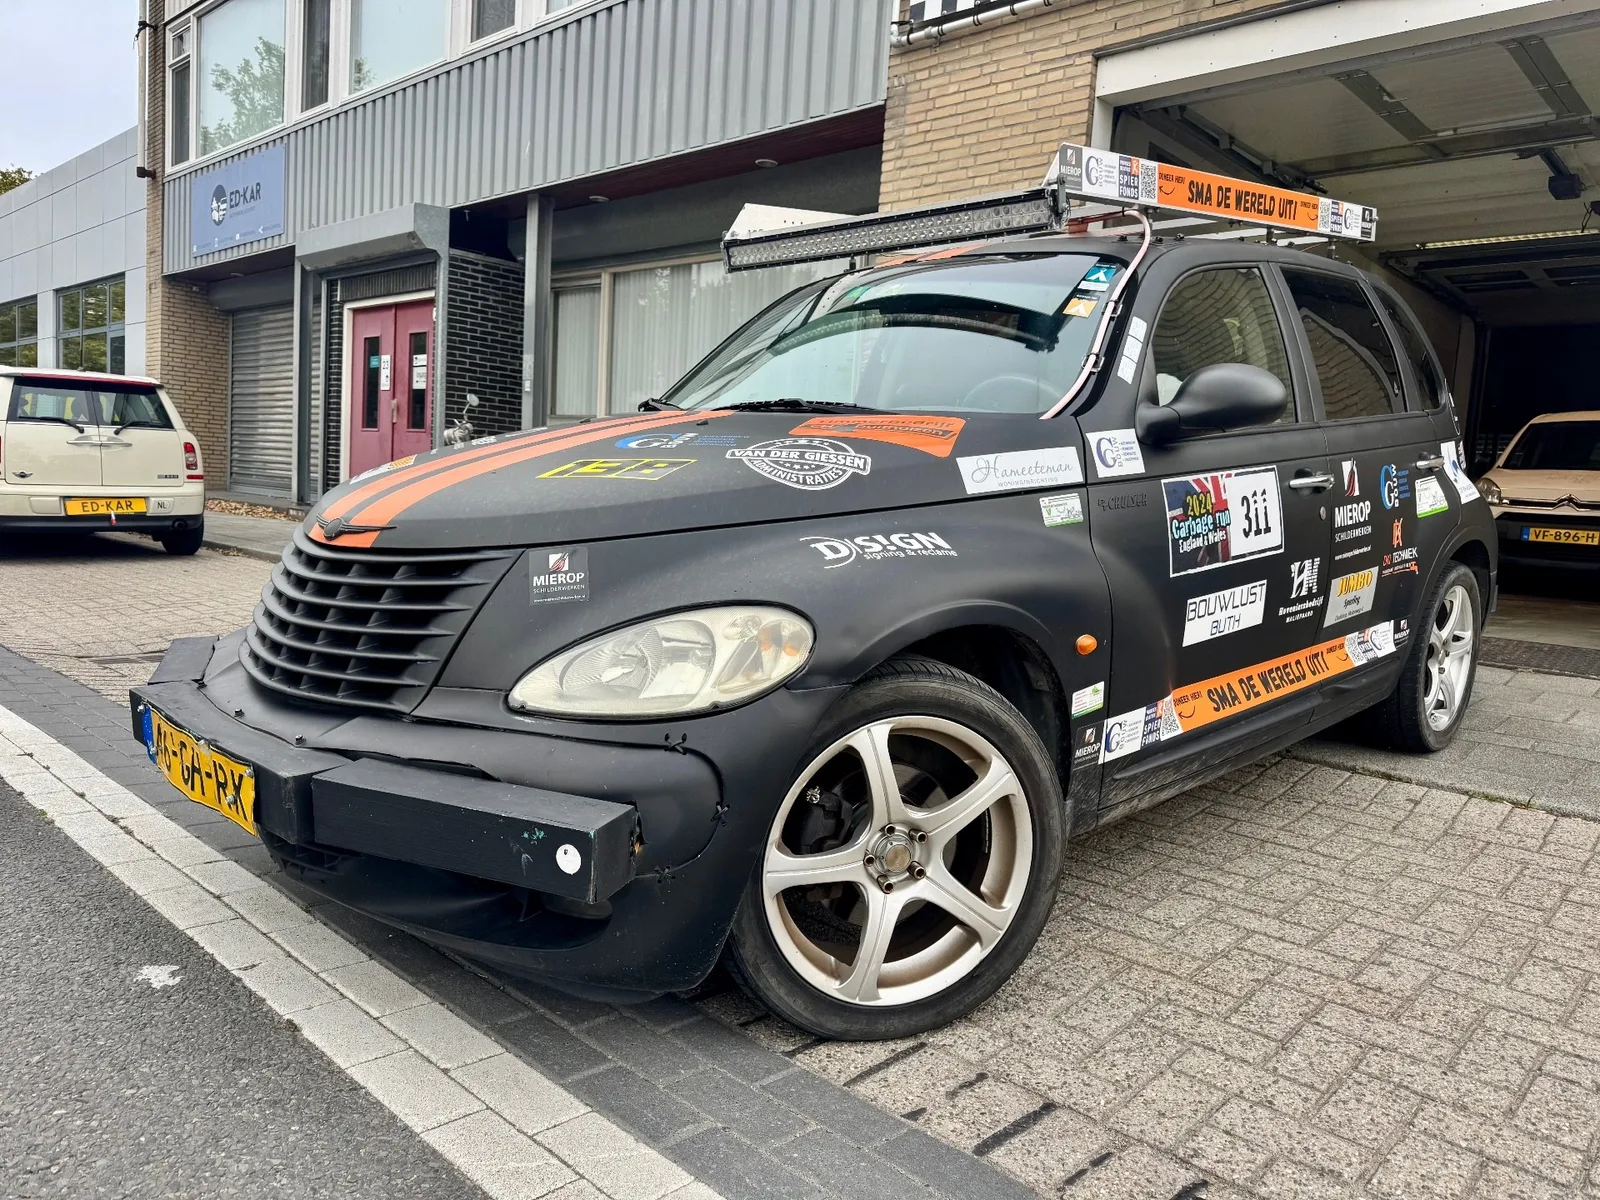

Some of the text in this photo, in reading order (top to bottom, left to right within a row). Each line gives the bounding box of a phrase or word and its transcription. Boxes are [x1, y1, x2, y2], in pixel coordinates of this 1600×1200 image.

[1061, 165, 1081, 176] MIEROP
[1120, 174, 1138, 187] SPIER
[229, 182, 261, 208] ED-KAR
[1120, 185, 1138, 198] FONDS
[1188, 180, 1297, 220] SMA DE WERELD UIT!
[770, 450, 800, 459] DER
[804, 452, 865, 469] GIESSEN
[750, 459, 843, 485] ADMINISTRATIES
[81, 500, 134, 513] ED-KAR
[157, 501, 167, 510] NL
[1186, 493, 1213, 516] 2024
[1241, 488, 1271, 538] 311
[1216, 510, 1231, 527] run
[1335, 500, 1370, 528] MIEROP
[1179, 537, 1204, 553] England
[1208, 529, 1227, 545] Wales
[1335, 525, 1371, 543] SCHILDERWERKEN
[1534, 529, 1597, 543] VF-896-H
[864, 550, 905, 560] signing
[918, 549, 958, 557] reclame
[533, 572, 585, 586] MIEROP
[1336, 571, 1373, 597] JUMBO
[533, 584, 585, 594] SCHILDERWERKEN
[1187, 583, 1266, 622] BOUWLUST
[1210, 613, 1241, 636] BUTH
[1207, 651, 1330, 713] SMA DE WERELD UIT!
[1075, 743, 1100, 758] MIEROP
